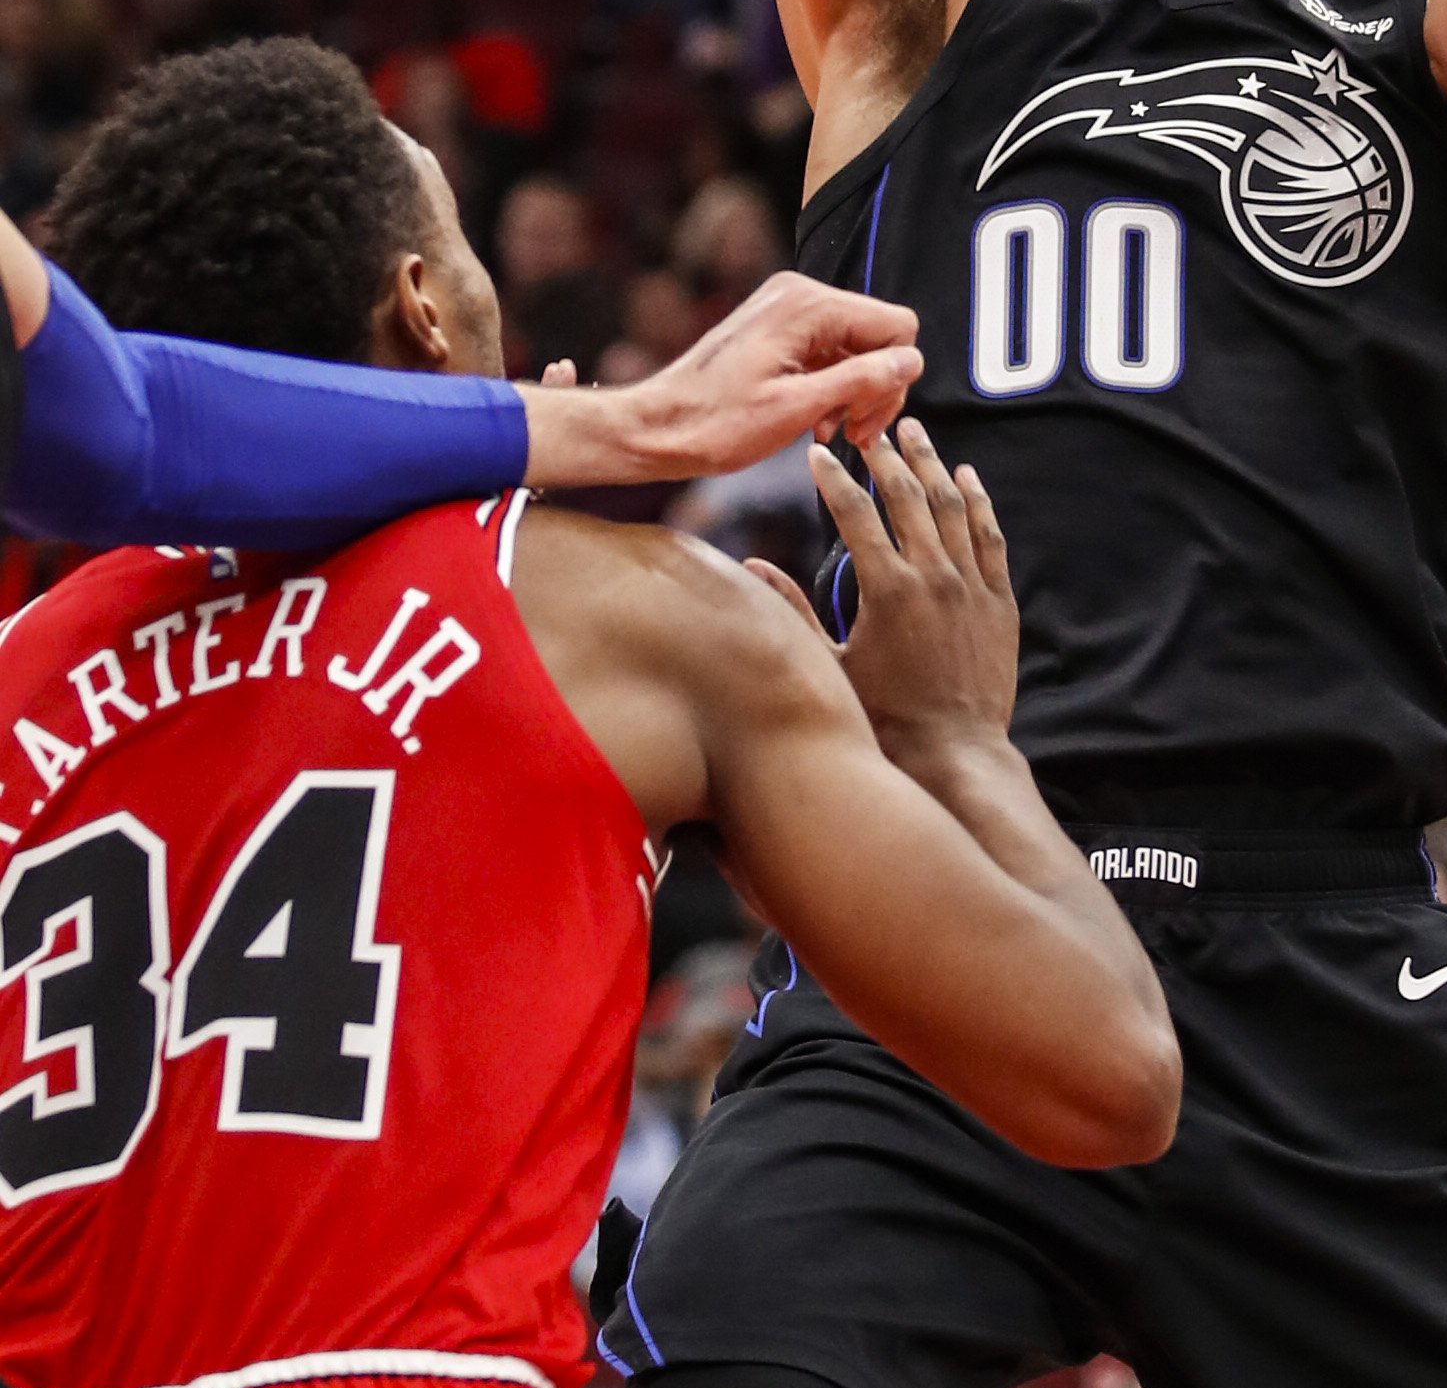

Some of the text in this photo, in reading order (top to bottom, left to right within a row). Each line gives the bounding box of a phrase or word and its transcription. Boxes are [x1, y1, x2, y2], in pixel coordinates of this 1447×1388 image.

[969, 198, 1186, 398] 00
[0, 577, 481, 844] ARTER JR.
[1089, 846, 1198, 889] ORLANDO
[0, 770, 401, 1208] 34
